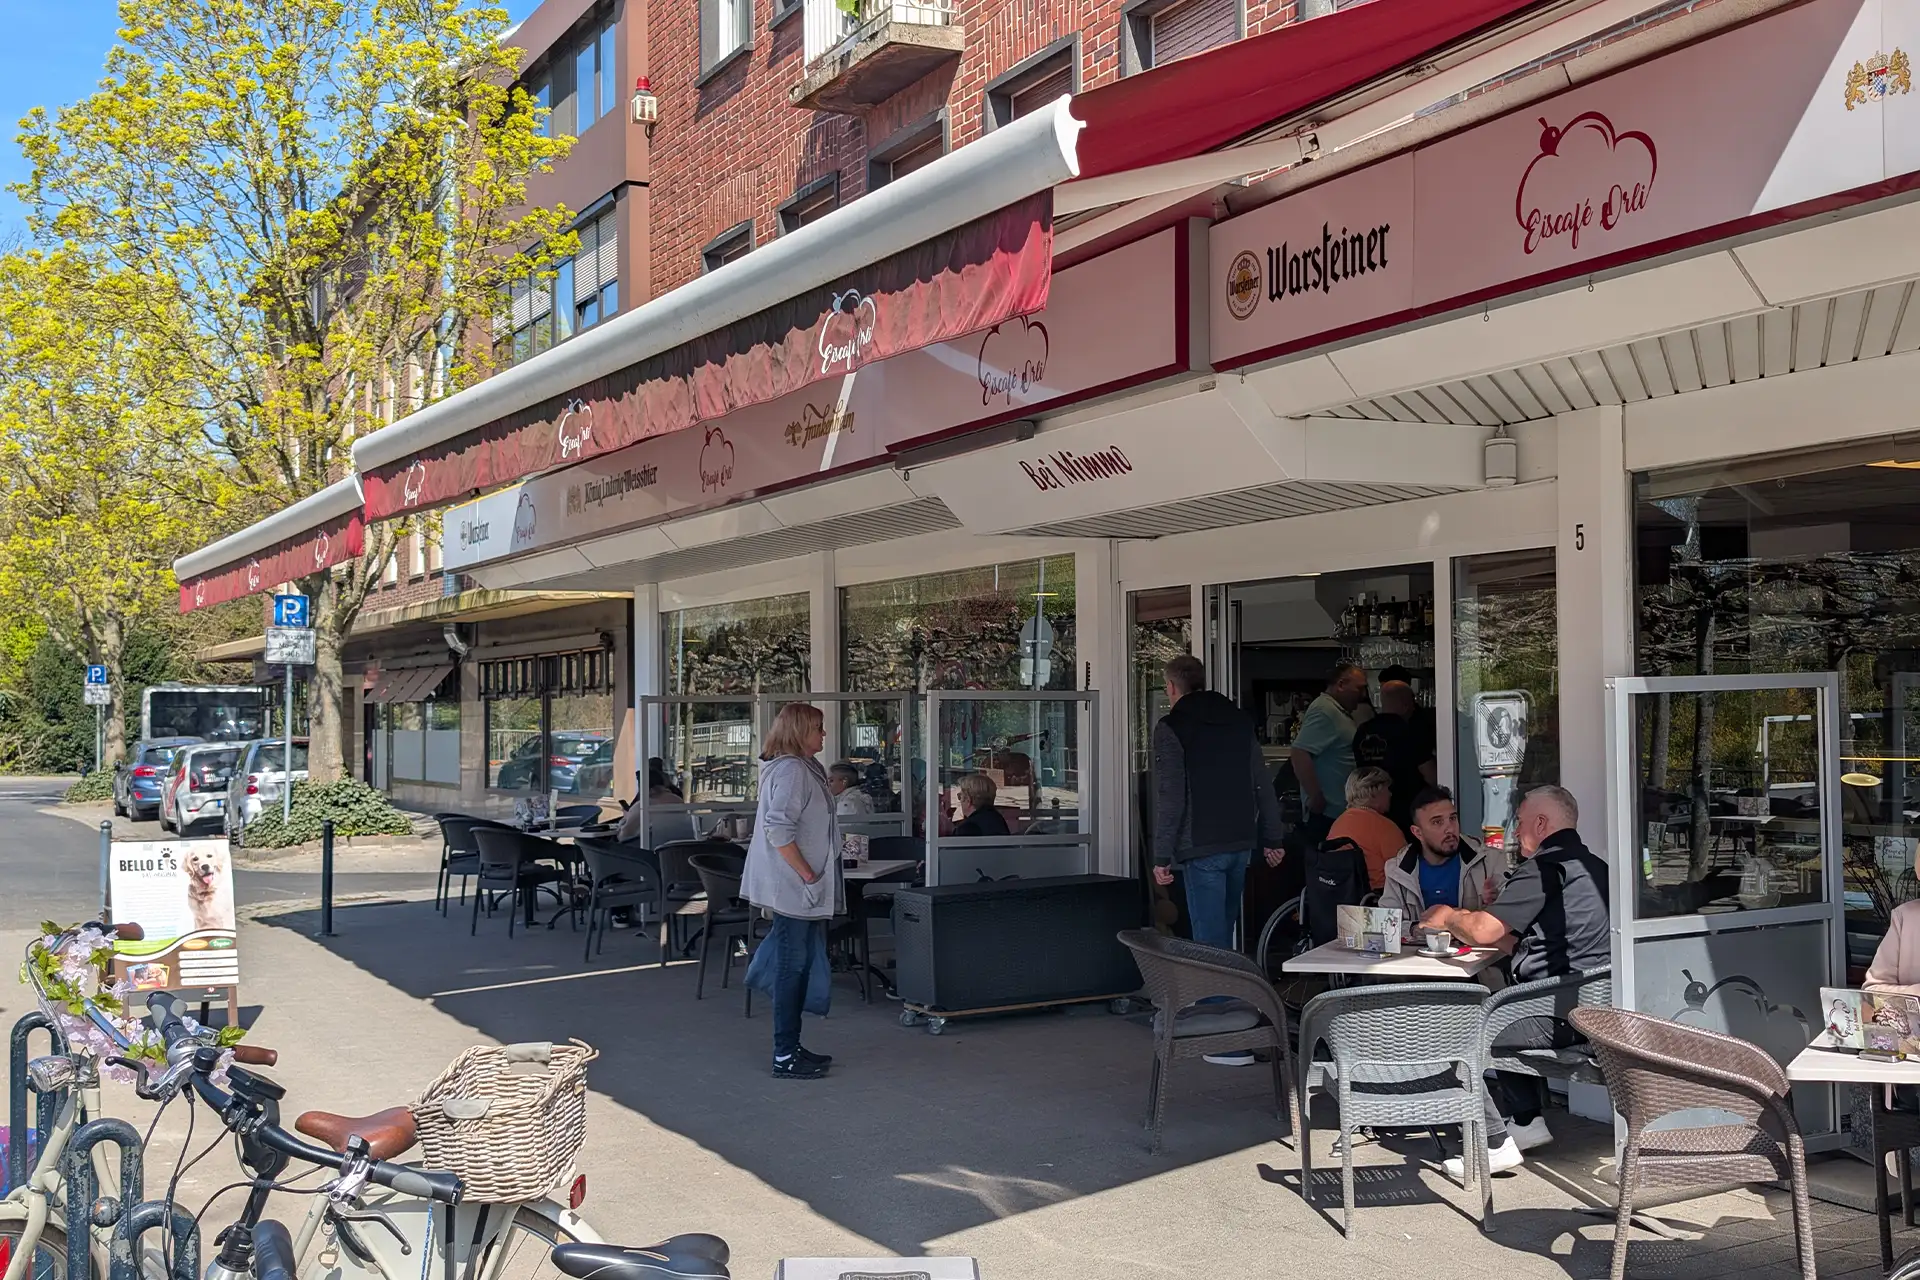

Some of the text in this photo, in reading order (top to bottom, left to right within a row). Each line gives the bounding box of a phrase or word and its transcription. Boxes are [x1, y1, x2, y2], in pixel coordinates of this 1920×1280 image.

[1524, 182, 1649, 255] Eiscafé Orli
[1267, 221, 1390, 303] Warsteiner
[1229, 275, 1260, 297] Warsteiner
[983, 359, 1043, 406] Eiscafé Orli
[802, 399, 855, 450] Frankenheim
[1018, 445, 1133, 491] Bei Mimmo
[1575, 523, 1585, 551] 5
[282, 598, 301, 623] P
[91, 667, 102, 682] P
[119, 859, 154, 872] BELLO
